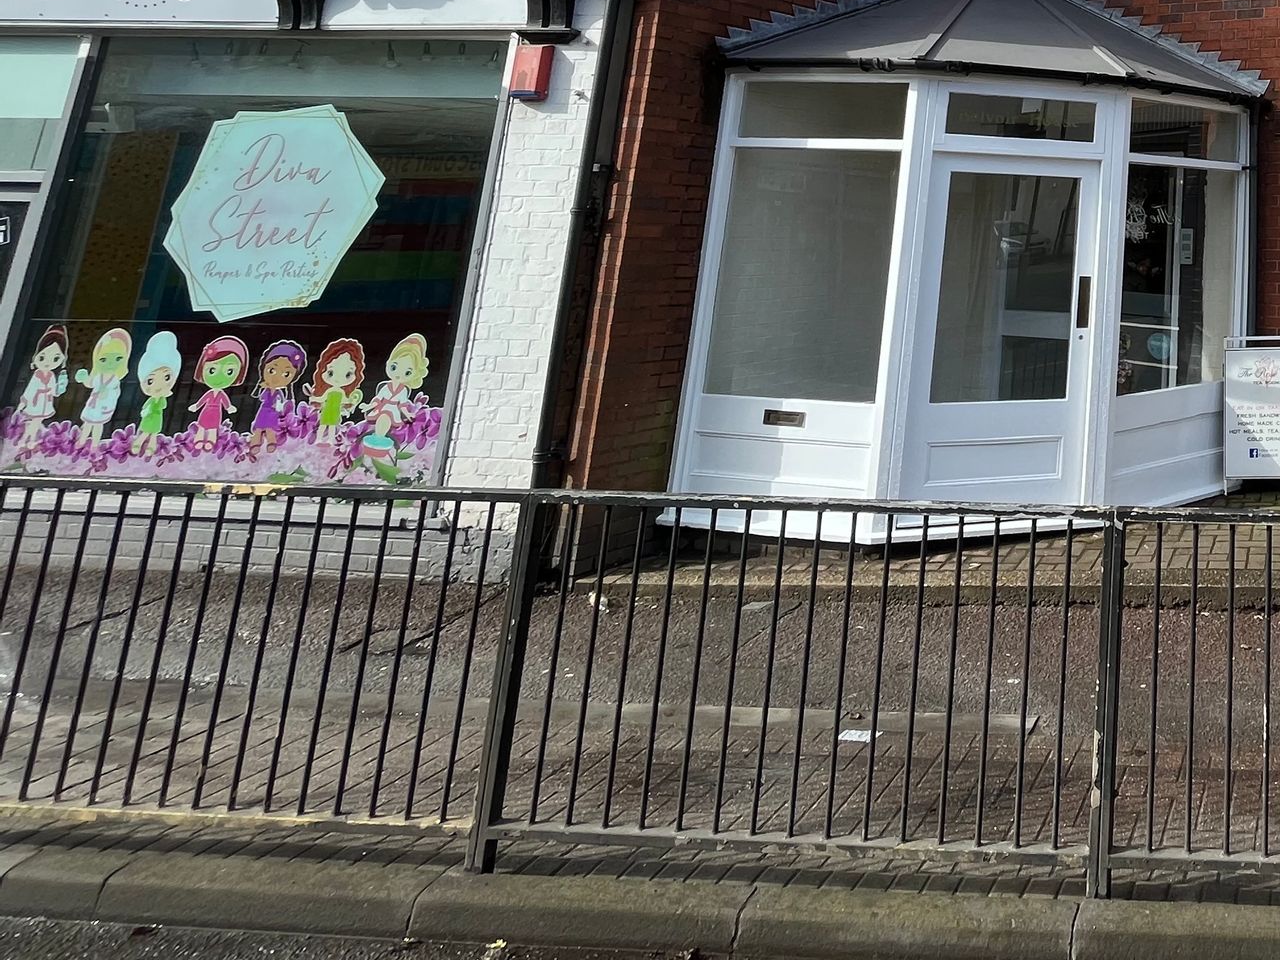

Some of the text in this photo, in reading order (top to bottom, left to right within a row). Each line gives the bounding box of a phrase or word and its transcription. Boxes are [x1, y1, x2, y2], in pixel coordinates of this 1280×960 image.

[232, 133, 332, 191] Diva
[202, 194, 335, 252] Street
[255, 260, 279, 284] Spa
[280, 260, 318, 279] Parties
[1238, 367, 1253, 378] The
